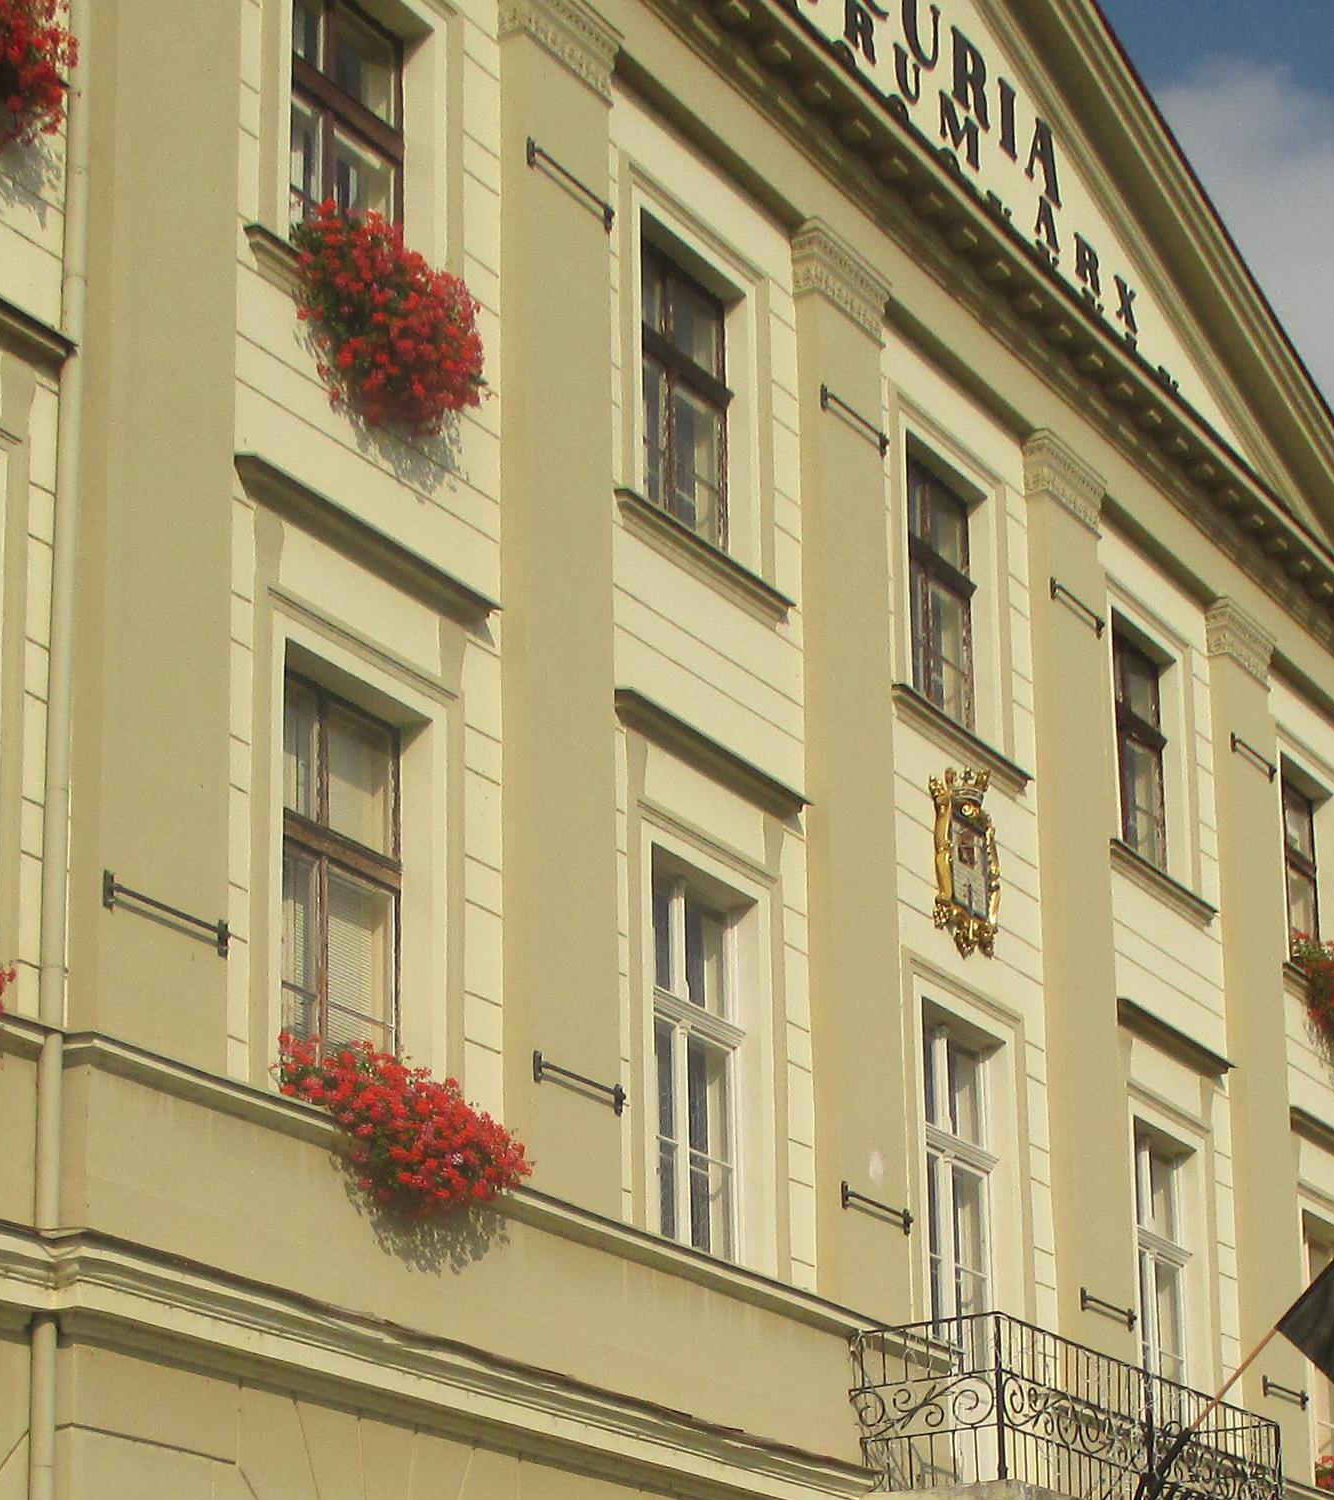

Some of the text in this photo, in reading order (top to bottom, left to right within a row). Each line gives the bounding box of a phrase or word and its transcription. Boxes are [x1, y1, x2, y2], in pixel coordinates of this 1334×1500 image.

[810, 0, 980, 173] RUM
[1034, 195, 1138, 334] ARX
[857, 0, 1064, 209] URIA
